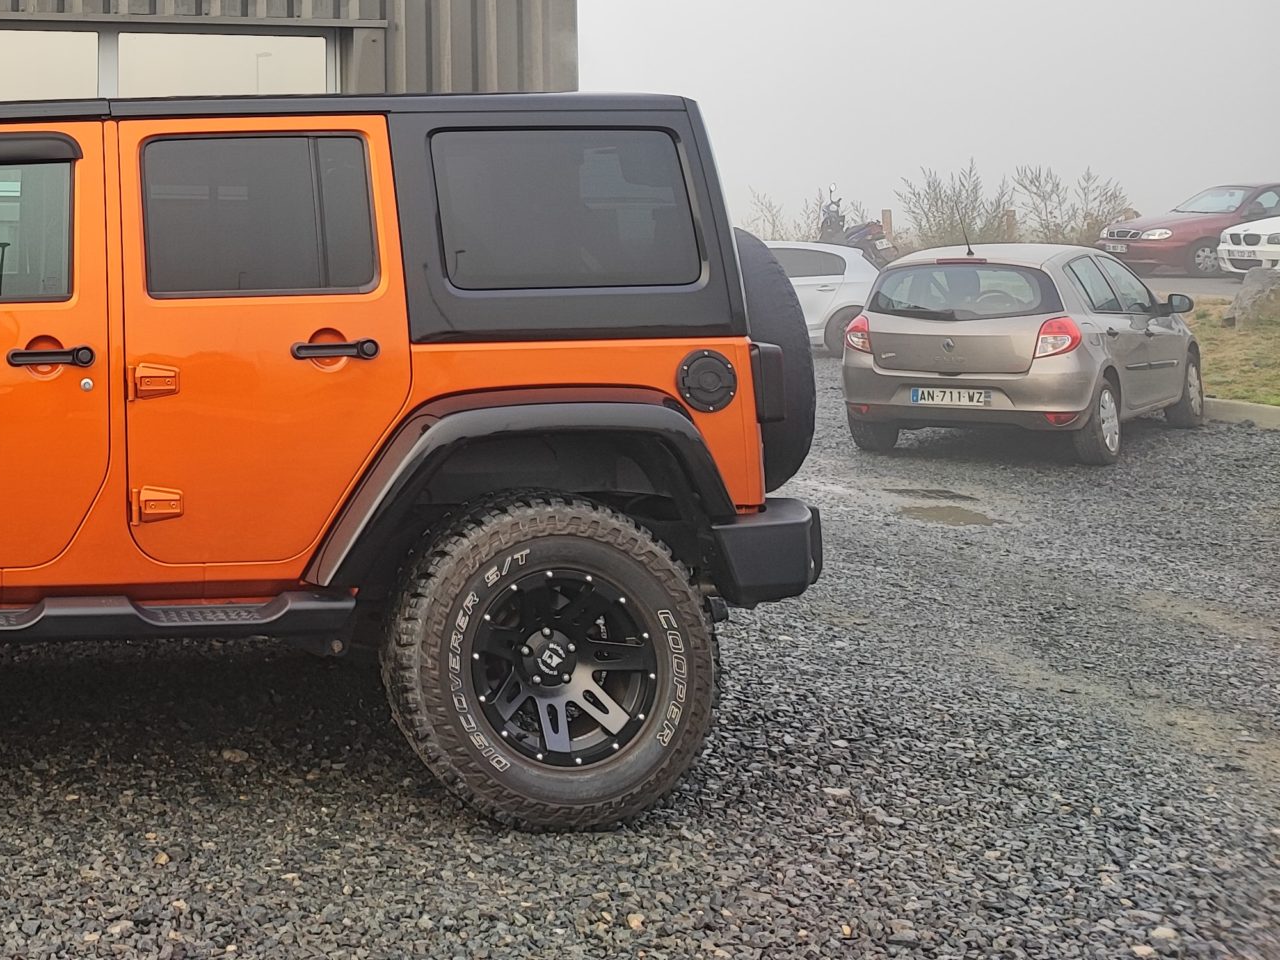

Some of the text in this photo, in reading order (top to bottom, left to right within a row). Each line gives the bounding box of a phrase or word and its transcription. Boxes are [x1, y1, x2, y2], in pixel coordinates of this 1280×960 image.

[449, 549, 531, 773] DISCOVERER S/T
[657, 609, 688, 747] COOPER
